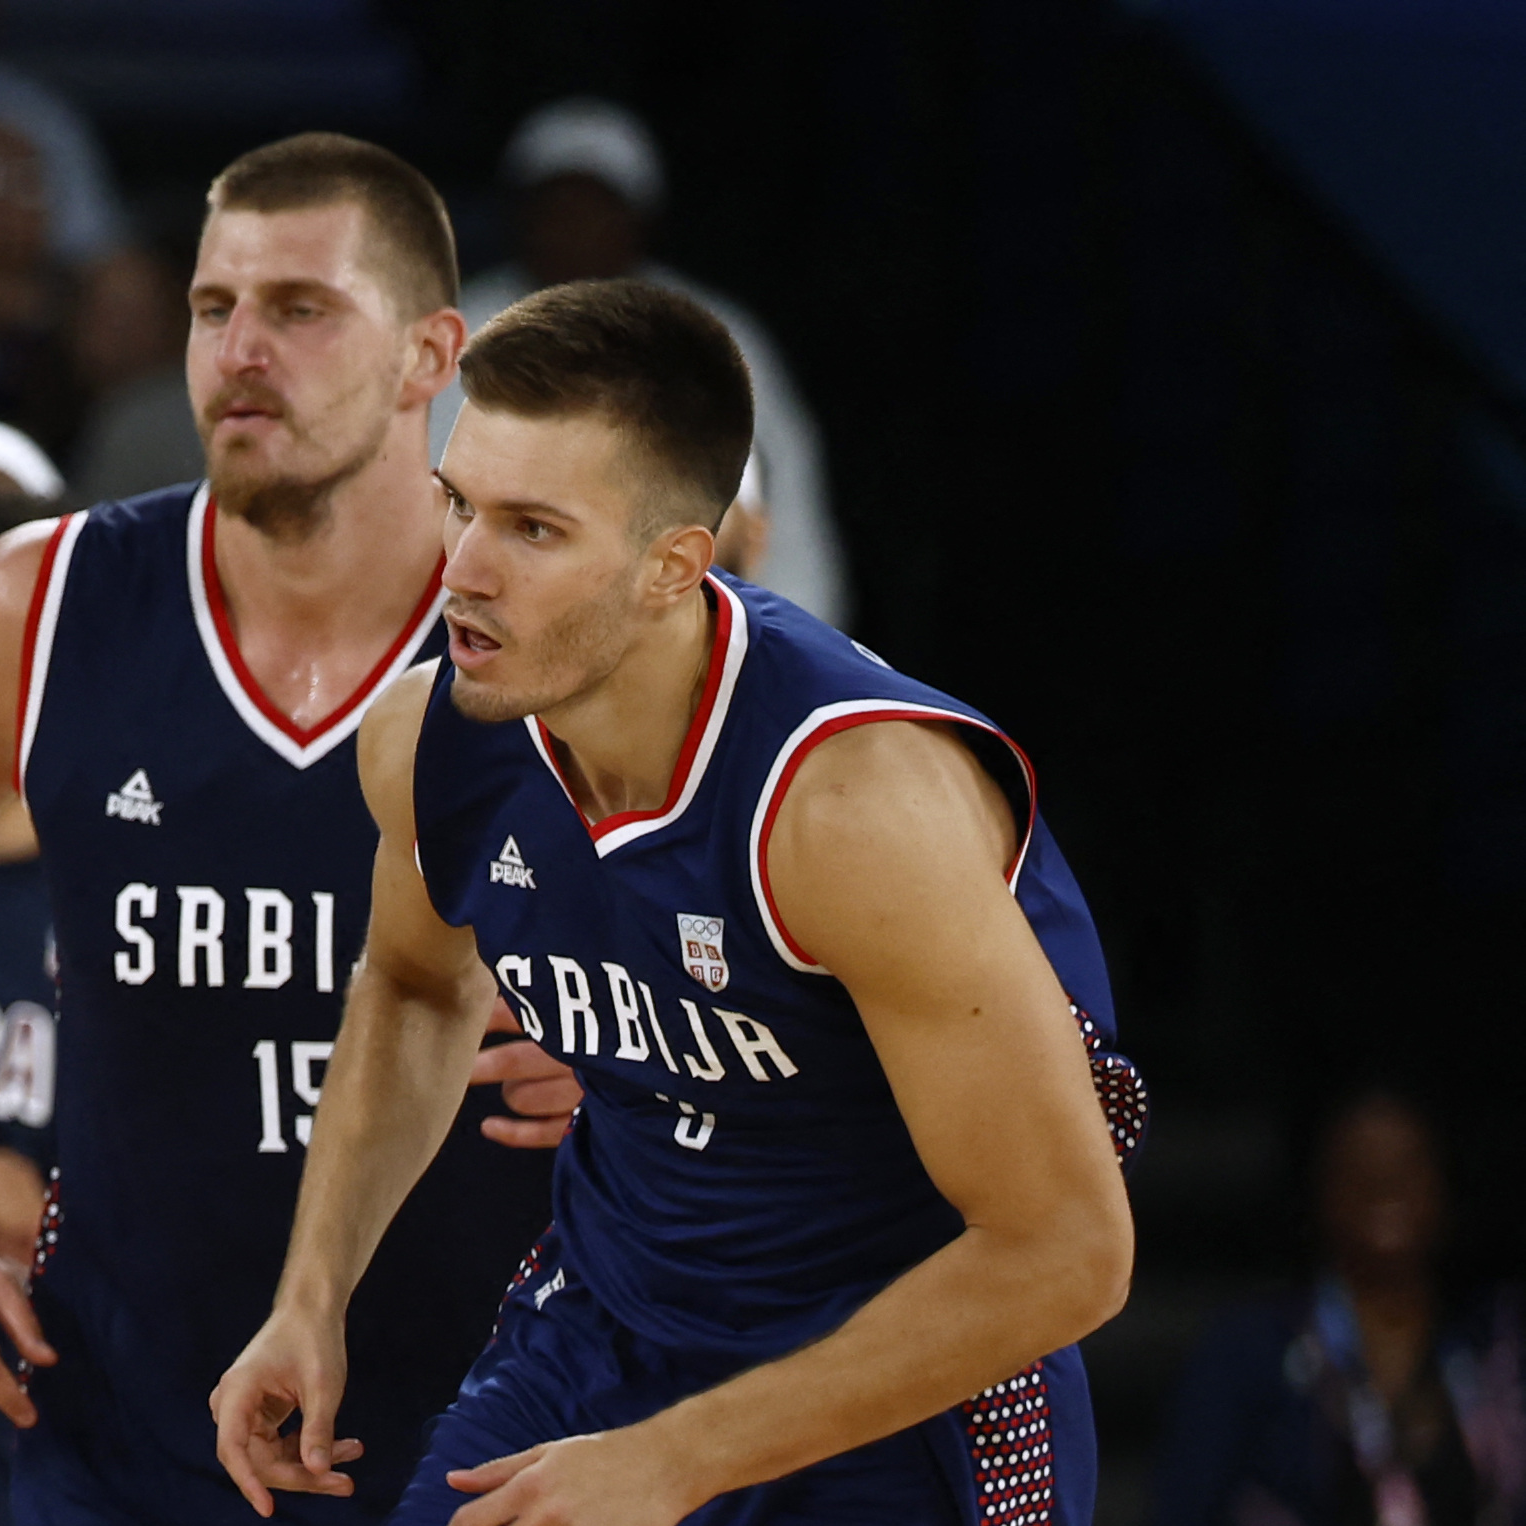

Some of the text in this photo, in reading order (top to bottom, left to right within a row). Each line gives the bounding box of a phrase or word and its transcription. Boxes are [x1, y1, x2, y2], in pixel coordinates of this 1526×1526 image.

[490, 860, 537, 890] PEAK
[114, 881, 338, 993] SRBI
[495, 954, 800, 1082] SRBIJA
